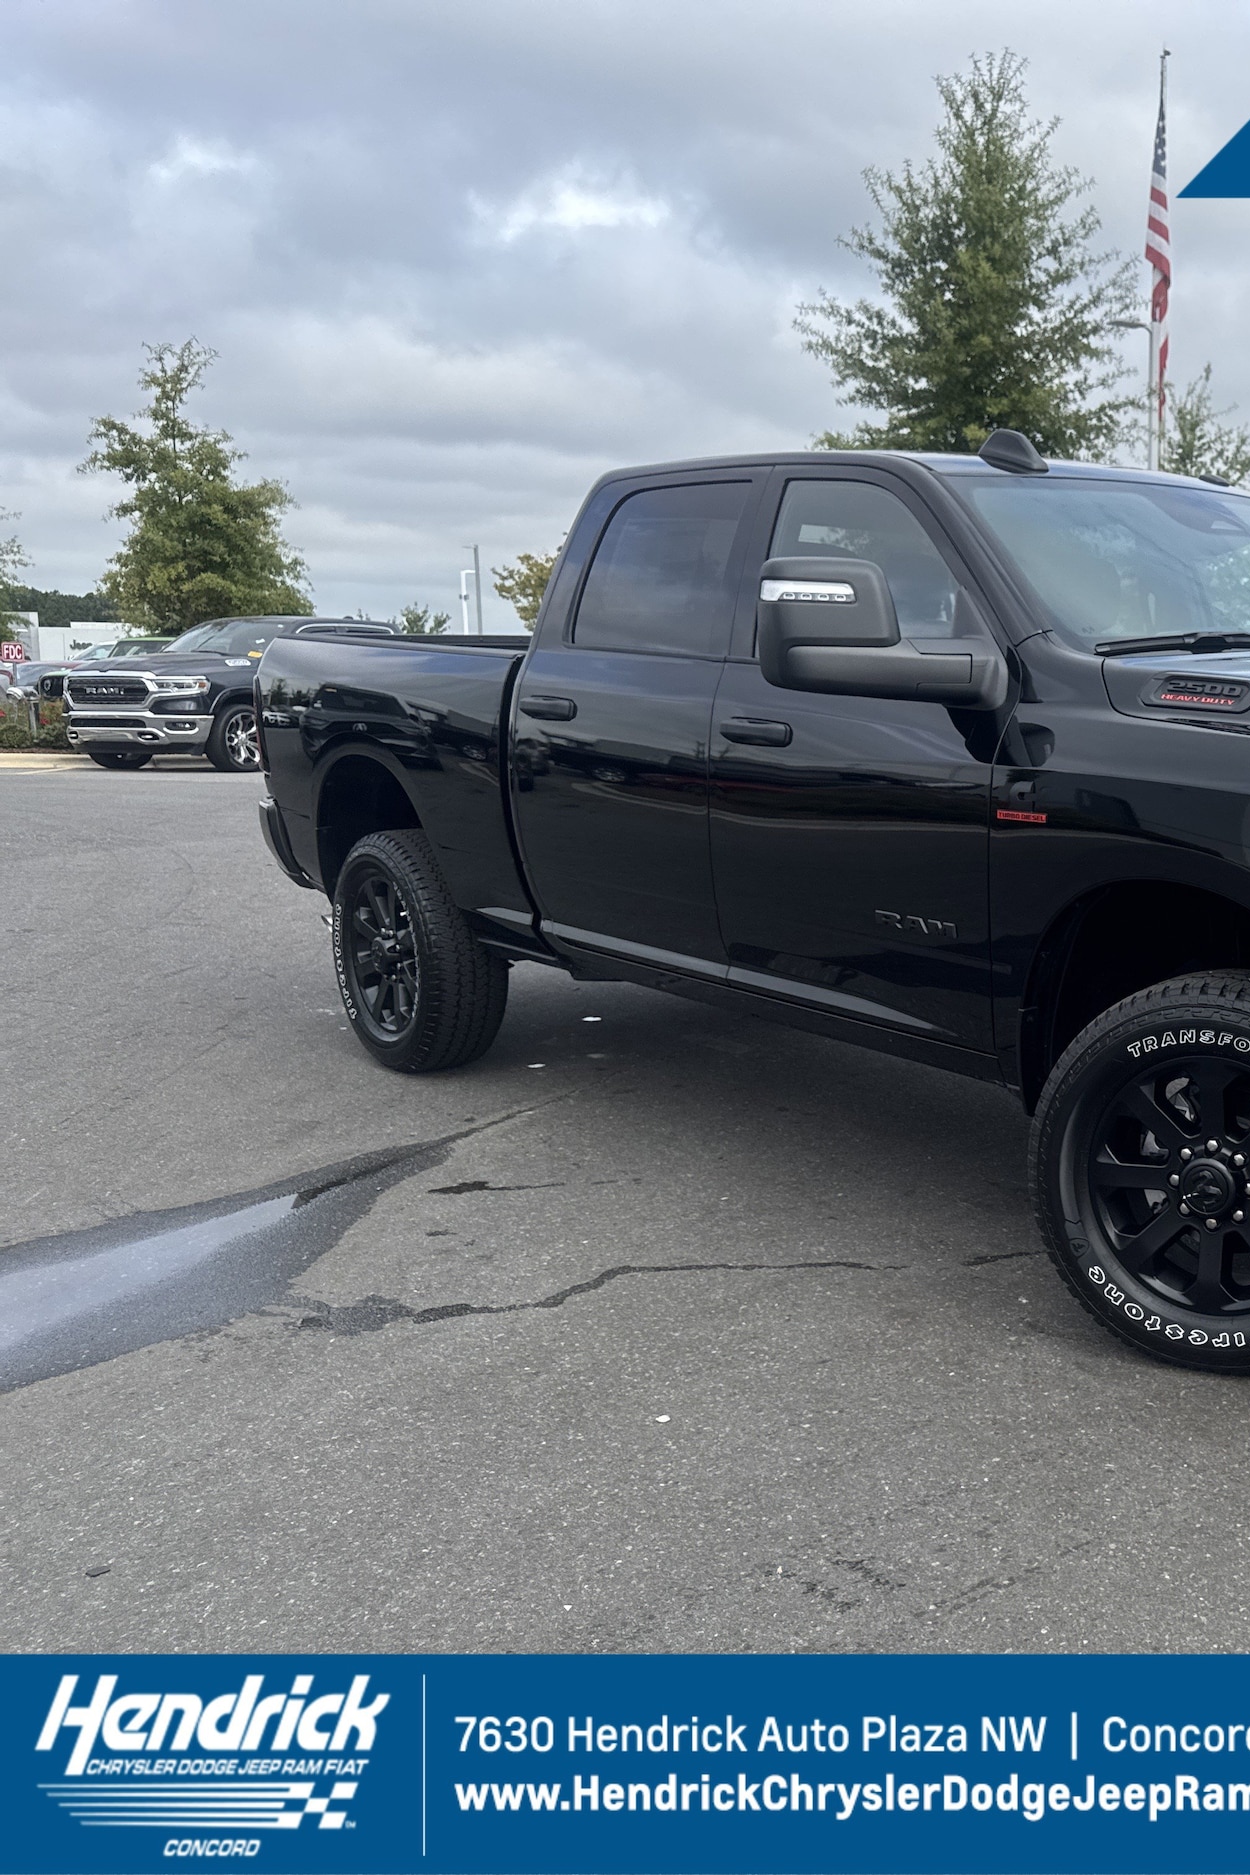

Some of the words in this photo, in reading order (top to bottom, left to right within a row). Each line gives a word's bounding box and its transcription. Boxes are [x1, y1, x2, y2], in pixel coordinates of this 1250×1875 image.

[3, 645, 22, 660] FDC
[1166, 680, 1241, 698] 2500
[1161, 694, 1200, 703] HEAVY
[1200, 697, 1235, 706] DUTY
[875, 909, 958, 939] RAM
